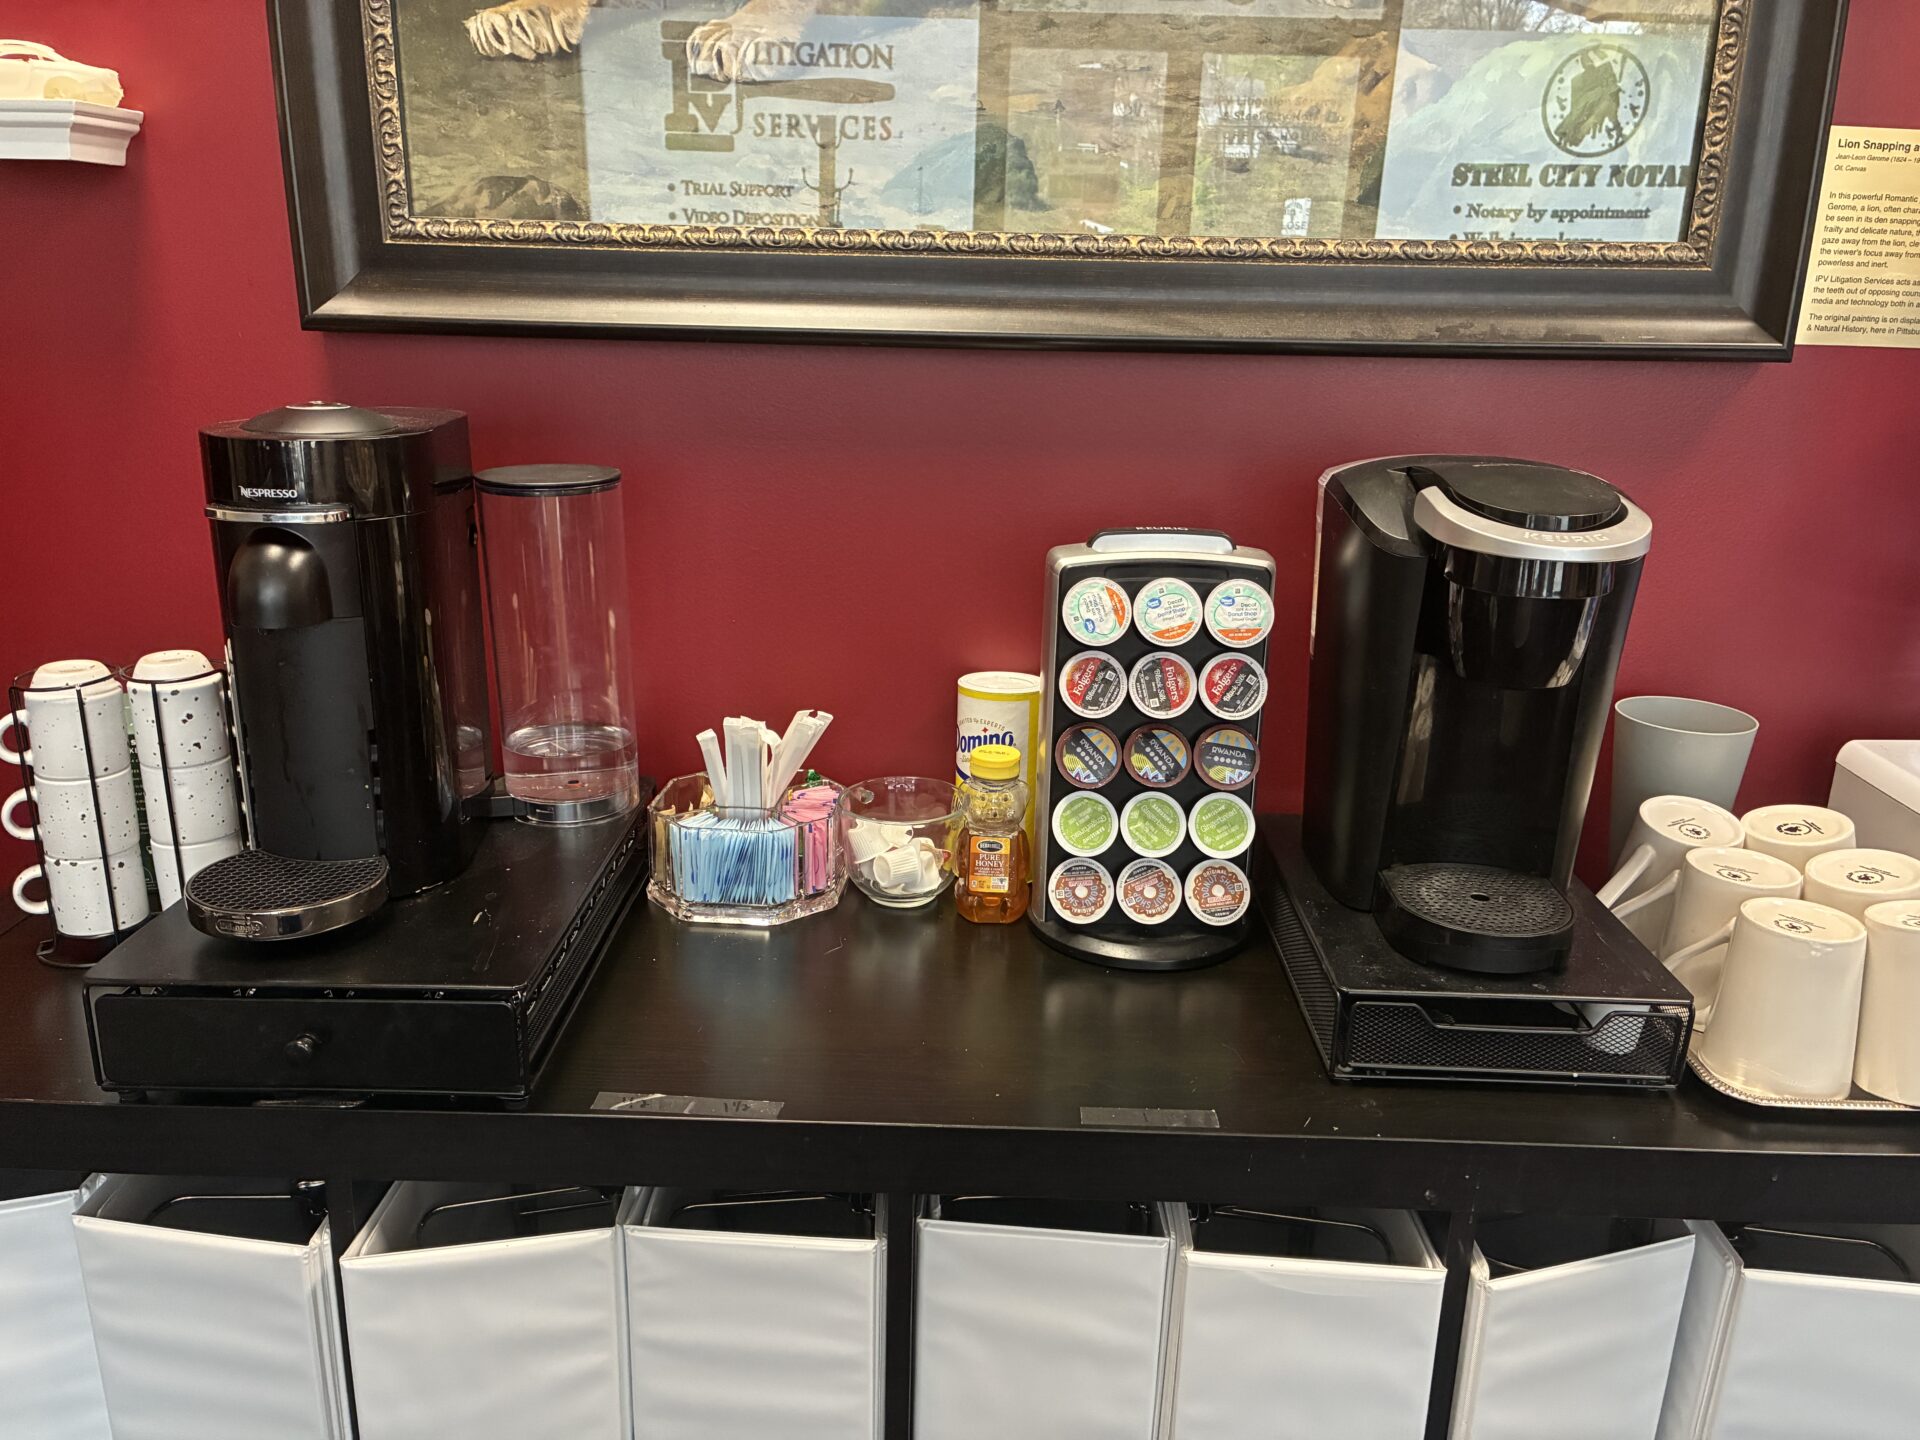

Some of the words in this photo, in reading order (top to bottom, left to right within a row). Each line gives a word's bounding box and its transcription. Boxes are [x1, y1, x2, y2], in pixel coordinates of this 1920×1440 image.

[753, 42, 894, 70] LITIGATION
[753, 112, 892, 141] SERVCES
[1838, 138, 1860, 149] Lion
[1863, 139, 1912, 154] Snapping
[1451, 163, 1533, 188] STEEL
[1539, 163, 1603, 188] CITY
[681, 180, 726, 196] TRIAL
[729, 181, 794, 198] SUPPORT
[1839, 192, 1851, 200] this
[1852, 193, 1884, 201] powerful
[1885, 194, 1919, 203] Romantic
[1465, 202, 1523, 222] Notary
[1527, 202, 1549, 223] by
[1550, 203, 1651, 223] appointment
[1827, 203, 1859, 211] Gerome,
[1867, 205, 1882, 213] lion,
[1884, 205, 1902, 213] often
[682, 208, 729, 225] VIDEO
[1826, 214, 1835, 222] be
[1856, 215, 1863, 223] in
[1874, 216, 1888, 224] den
[1860, 227, 1888, 235] delicate
[1889, 229, 1914, 237] nature,
[1822, 238, 1840, 246] gaze
[1841, 239, 1861, 247] away
[1862, 238, 1879, 246] from
[1893, 239, 1907, 248] lion,
[1833, 248, 1863, 257] viewer's
[1864, 249, 1883, 257] focus
[1884, 251, 1904, 259] away
[1818, 259, 1854, 268] powerless
[1856, 260, 1869, 268] and
[1871, 261, 1889, 269] inert.
[1815, 275, 1829, 283] IPV
[1830, 276, 1863, 284] Litigation
[1864, 277, 1895, 285] Services
[1813, 286, 1825, 294] the
[1827, 287, 1845, 295] teeth
[1868, 289, 1900, 298] opposing
[1851, 299, 1889, 308] technology
[1890, 299, 1906, 307] both
[1908, 300, 1915, 308] in
[1809, 313, 1823, 321] The
[1824, 313, 1851, 323] original
[1852, 314, 1880, 324] painting
[1882, 315, 1888, 323] is
[1814, 324, 1840, 332] Natural
[1841, 325, 1869, 335] History,
[1870, 326, 1887, 334] here
[238, 486, 298, 499] NESPRESSO
[1523, 531, 1610, 544] KEURIG
[1073, 663, 1095, 696] Folgers
[1086, 683, 1099, 701] Black
[1095, 670, 1106, 684] Silk
[1154, 668, 1164, 689] Black
[1165, 666, 1178, 701] Folgers
[1211, 665, 1237, 696] Folgers
[1223, 684, 1239, 702] Black
[1235, 673, 1247, 687] Silk
[1158, 689, 1167, 703] Silk
[980, 718, 1006, 732] EXPERTS
[1079, 738, 1106, 768] RWANDA
[1149, 738, 1175, 769] RWANDA
[1211, 746, 1247, 759] RWANDA
[1071, 815, 1107, 842] Gingerbread
[1141, 804, 1174, 837] Gingerbread
[1200, 808, 1238, 833] Gingerbread
[975, 859, 1004, 868] HONEY
[979, 853, 1001, 861] PURE
[1203, 870, 1228, 878] ORIGINAL
[1202, 874, 1218, 898] DONUT
[1220, 876, 1236, 895] SHOP
[1064, 887, 1080, 907] SHOP
[1082, 885, 1099, 907] DONUT
[1133, 892, 1152, 909] SHOP
[1154, 882, 1167, 907] DONUT
[1146, 903, 1169, 915] ORIGINAL
